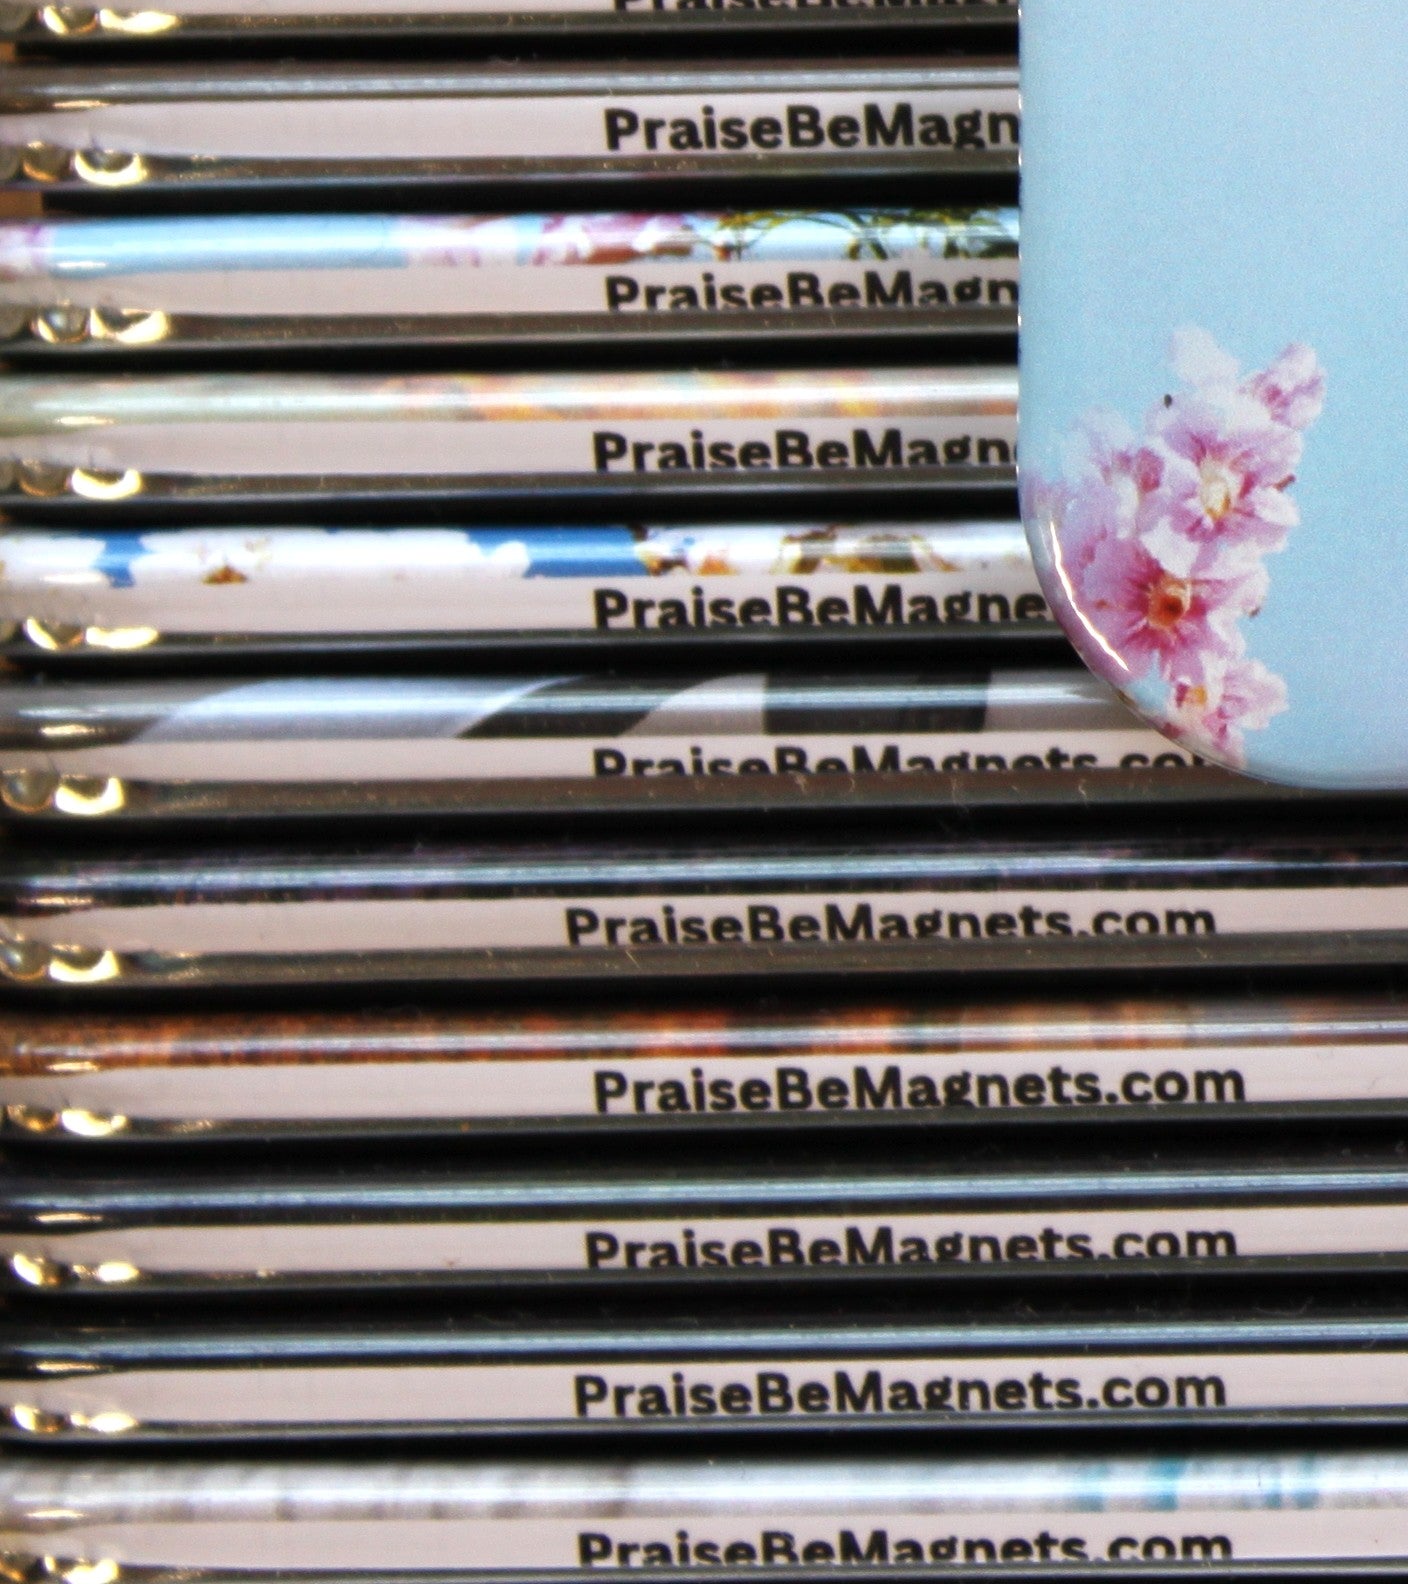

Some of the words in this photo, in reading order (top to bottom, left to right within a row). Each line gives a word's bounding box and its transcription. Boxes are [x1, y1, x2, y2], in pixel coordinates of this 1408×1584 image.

[593, 428, 1018, 472] PraiseBeMagn
[565, 904, 1216, 946] PraiseBeMagnets.com
[594, 1065, 1246, 1113] PraiseBeMagnets.com
[585, 1226, 1237, 1268] PraiseBeMagnets.com
[574, 1370, 1226, 1417] PraiseBeMagnets.com
[577, 1529, 1232, 1568] PraiseBeMagnets.com
